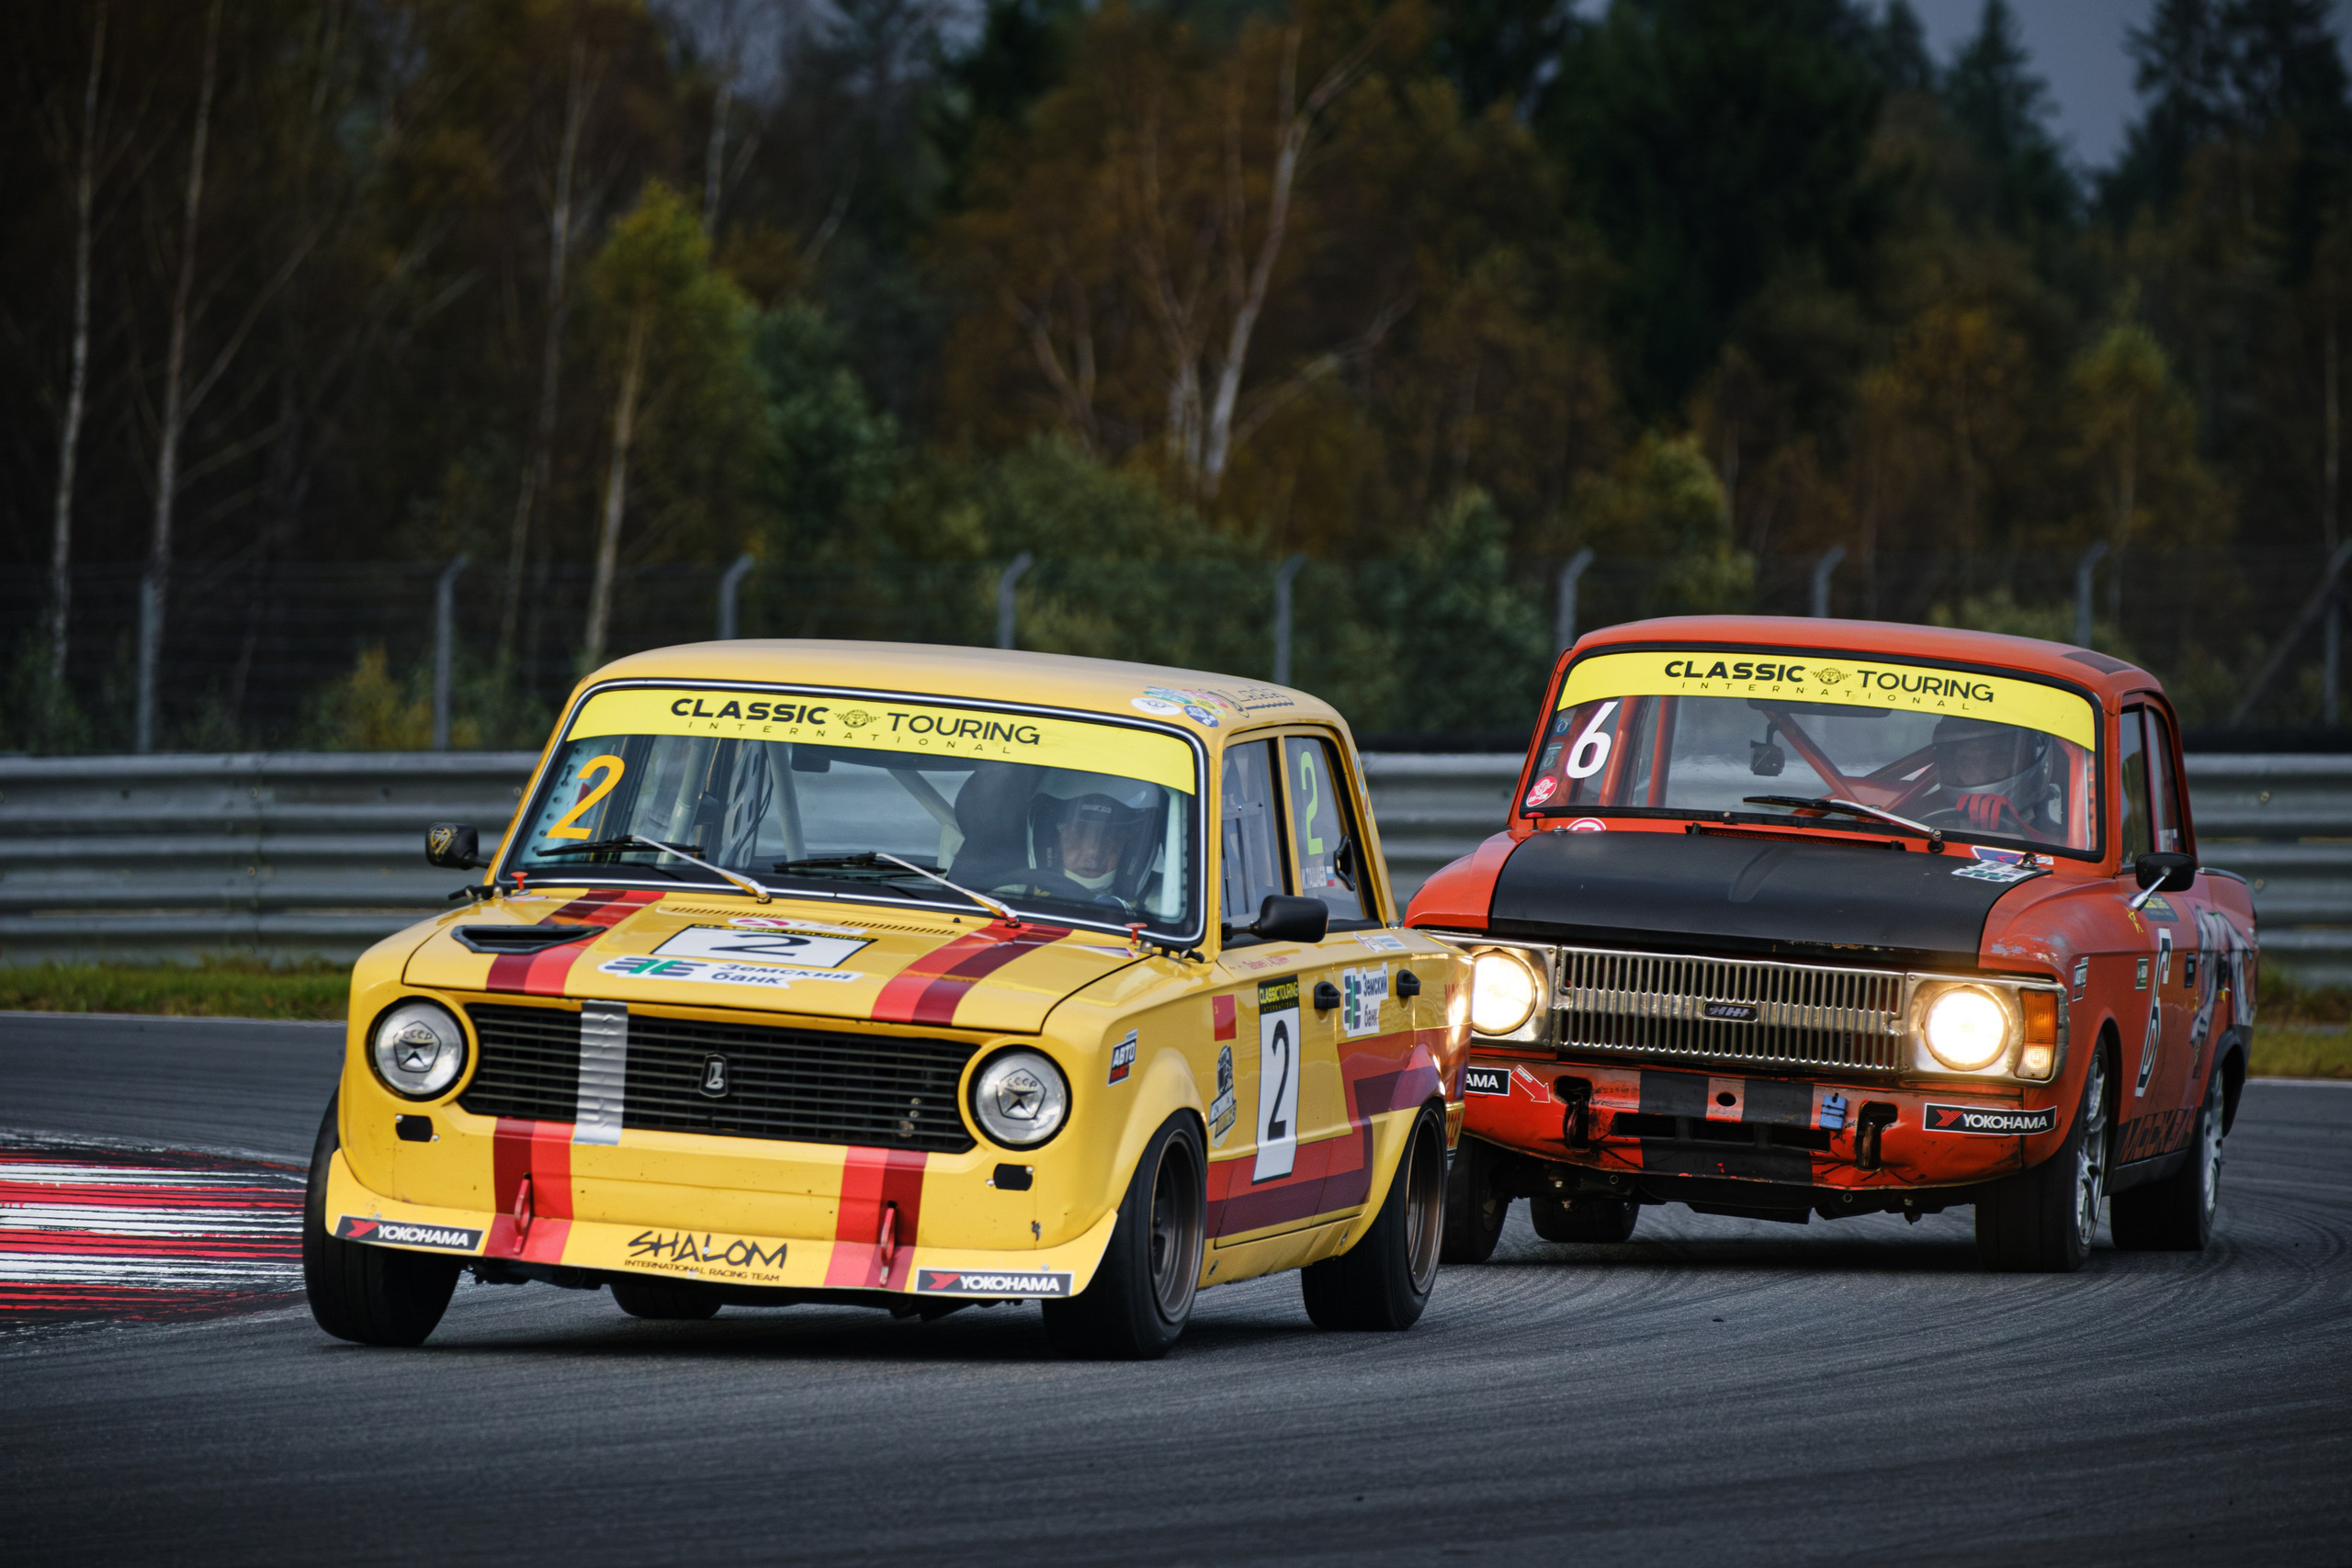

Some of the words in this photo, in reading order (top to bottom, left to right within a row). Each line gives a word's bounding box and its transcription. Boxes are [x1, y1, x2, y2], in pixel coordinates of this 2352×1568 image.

[1665, 660, 1806, 682] CLASSIC
[1857, 670, 1995, 703] TOURING
[1681, 682, 1971, 710] INTERNATIONAL
[671, 698, 830, 725] CLASSIC
[887, 712, 1041, 746] TOURING
[688, 721, 1012, 754] INTERNATIONAL
[1566, 701, 1619, 779] 6
[545, 754, 625, 840] 2
[1300, 751, 1324, 855] 2
[708, 934, 812, 957] 2
[711, 972, 786, 986] банк
[716, 964, 856, 981] Земский
[1363, 970, 1388, 998] Земский
[1364, 1003, 1378, 1027] банк
[2135, 928, 2173, 1097] 6
[402, 1030, 433, 1040] СССР
[1113, 1042, 1136, 1068] АВТО
[1007, 1077, 1037, 1088] СССР
[1268, 1020, 1290, 1141] 2
[1962, 1112, 2048, 1130] YOKOHAMA
[378, 1224, 469, 1247] YOKOHAMA
[628, 1231, 787, 1269] SHALOM
[625, 1259, 706, 1275] INTERNATIONAL
[708, 1269, 748, 1280] RACING
[752, 1272, 780, 1282] TEAM
[959, 1275, 1060, 1292] YOKOHAMA
